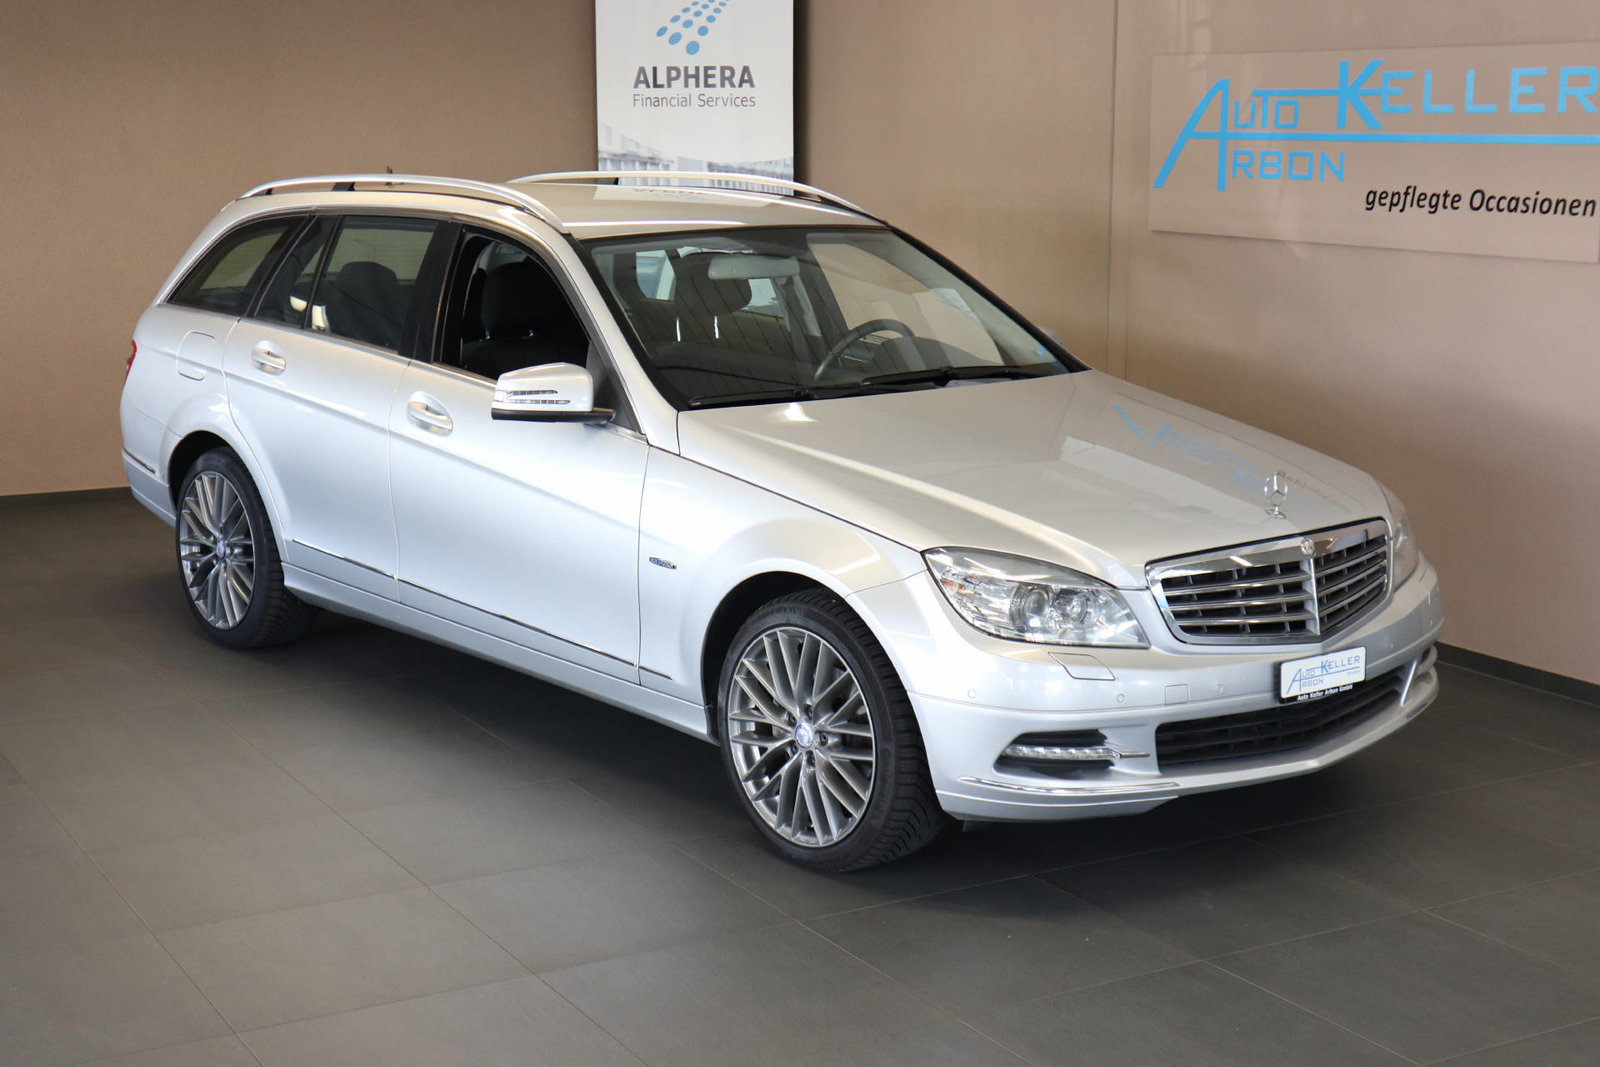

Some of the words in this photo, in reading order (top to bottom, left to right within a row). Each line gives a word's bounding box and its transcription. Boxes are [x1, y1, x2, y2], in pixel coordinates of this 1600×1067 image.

[633, 65, 756, 89] ALPHERA
[632, 93, 692, 108] Financial
[697, 93, 756, 108] Services
[1336, 59, 1600, 130] KELLER
[1364, 185, 1462, 214] gepflegte
[1469, 189, 1597, 217] Occasionen
